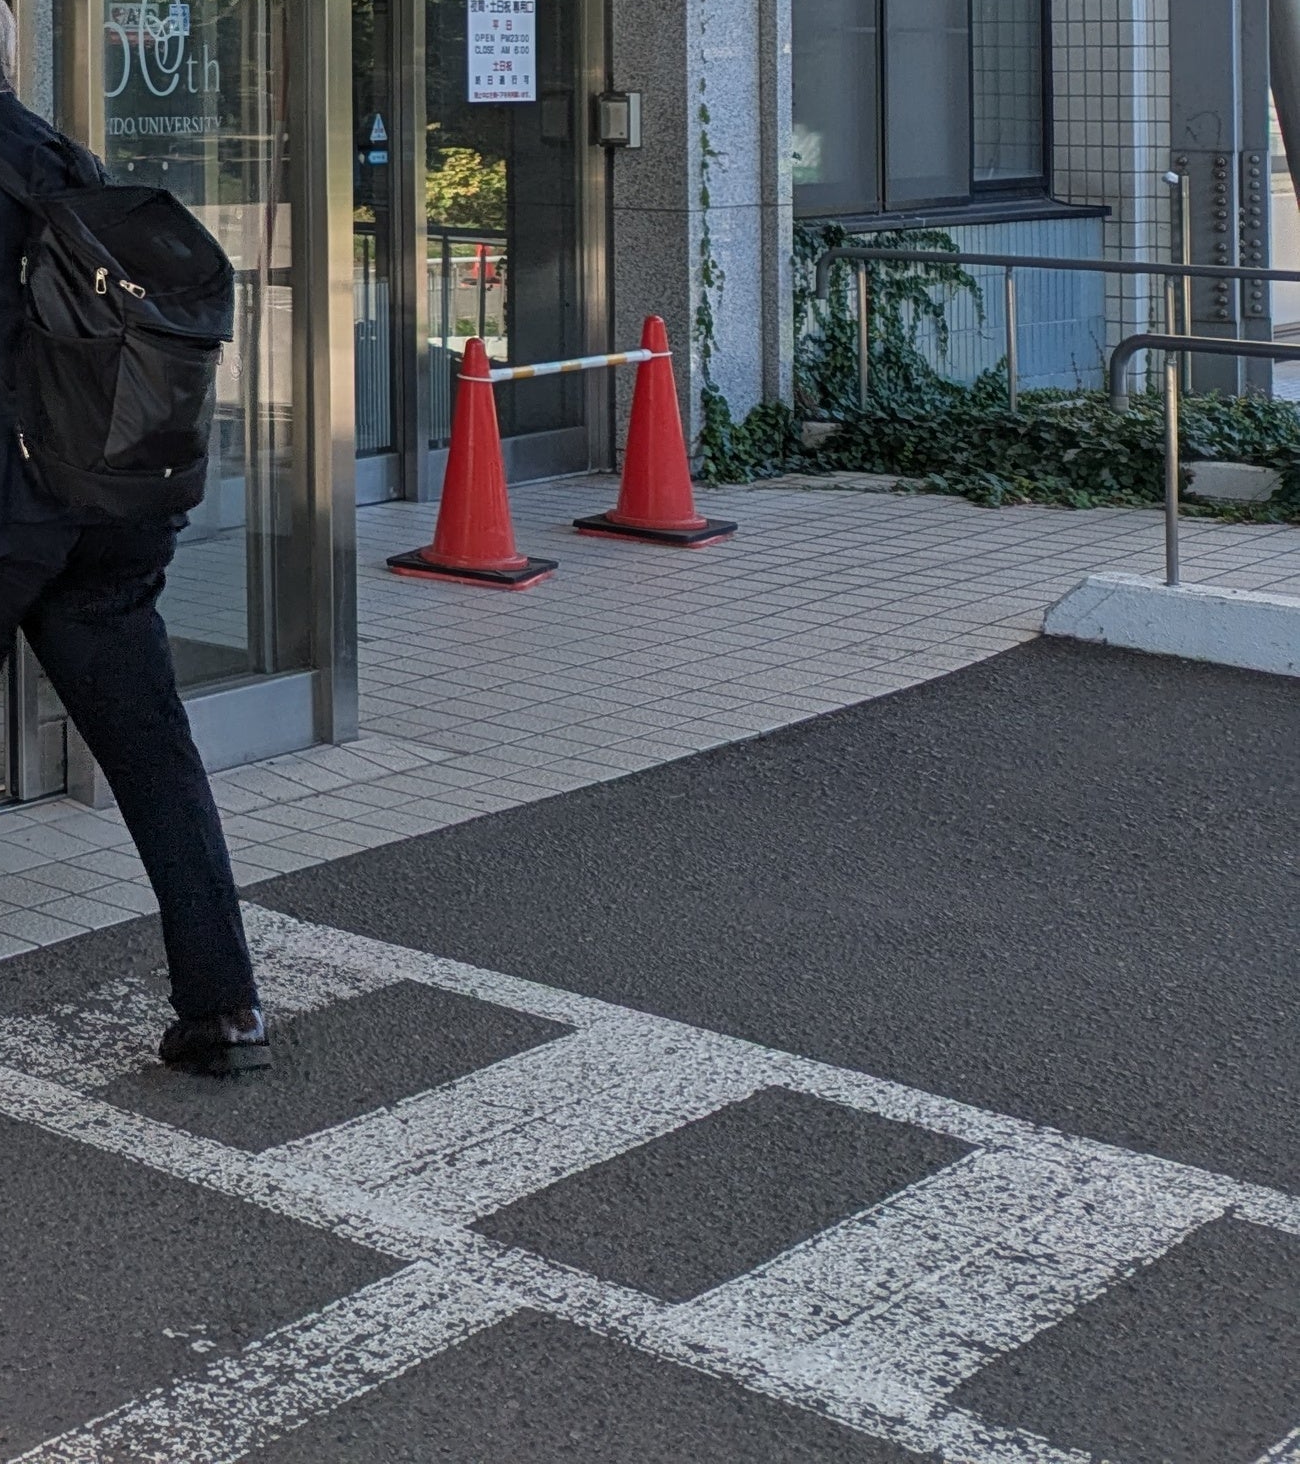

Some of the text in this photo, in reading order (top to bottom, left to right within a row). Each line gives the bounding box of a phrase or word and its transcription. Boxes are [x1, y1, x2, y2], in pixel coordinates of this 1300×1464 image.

[474, 34, 496, 43] OPEN
[474, 45, 495, 55] CLOSE
[138, 115, 224, 136] UNIVERSITY
